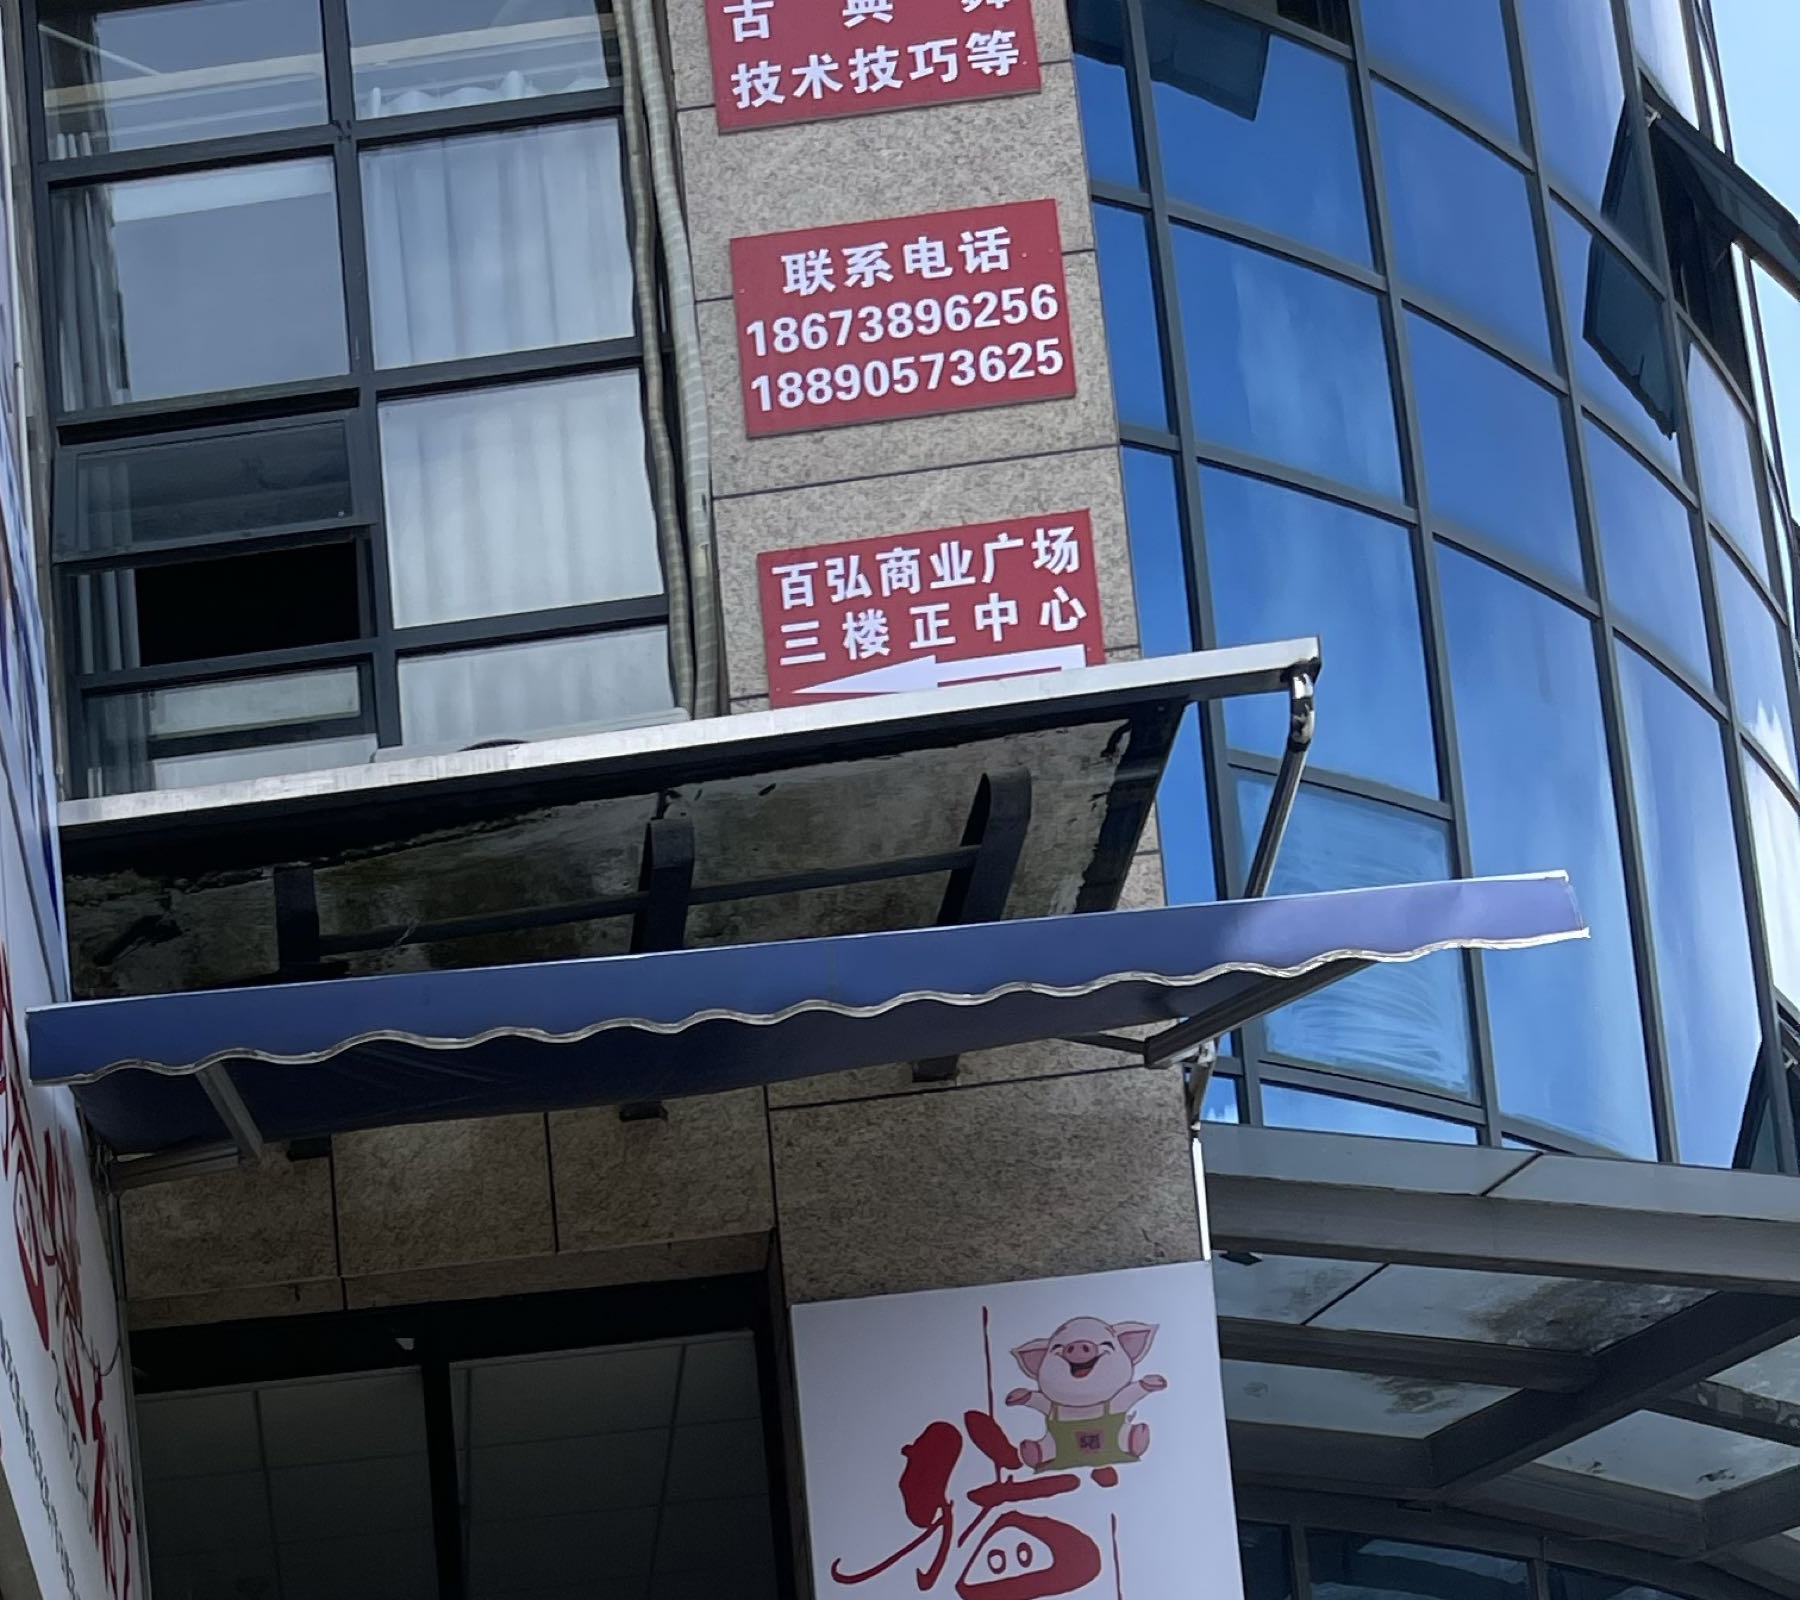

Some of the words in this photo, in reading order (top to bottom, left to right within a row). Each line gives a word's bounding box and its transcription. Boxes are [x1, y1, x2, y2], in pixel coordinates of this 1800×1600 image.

[723, 0, 1011, 42] 古典
[730, 29, 1020, 109] 技术技巧等
[781, 226, 1012, 295] 联系电话
[745, 284, 1059, 358] 18673896256
[750, 337, 1065, 412] 18890573625
[771, 525, 1081, 611] 百弘商业广场
[780, 587, 1087, 666] 三楼正中心
